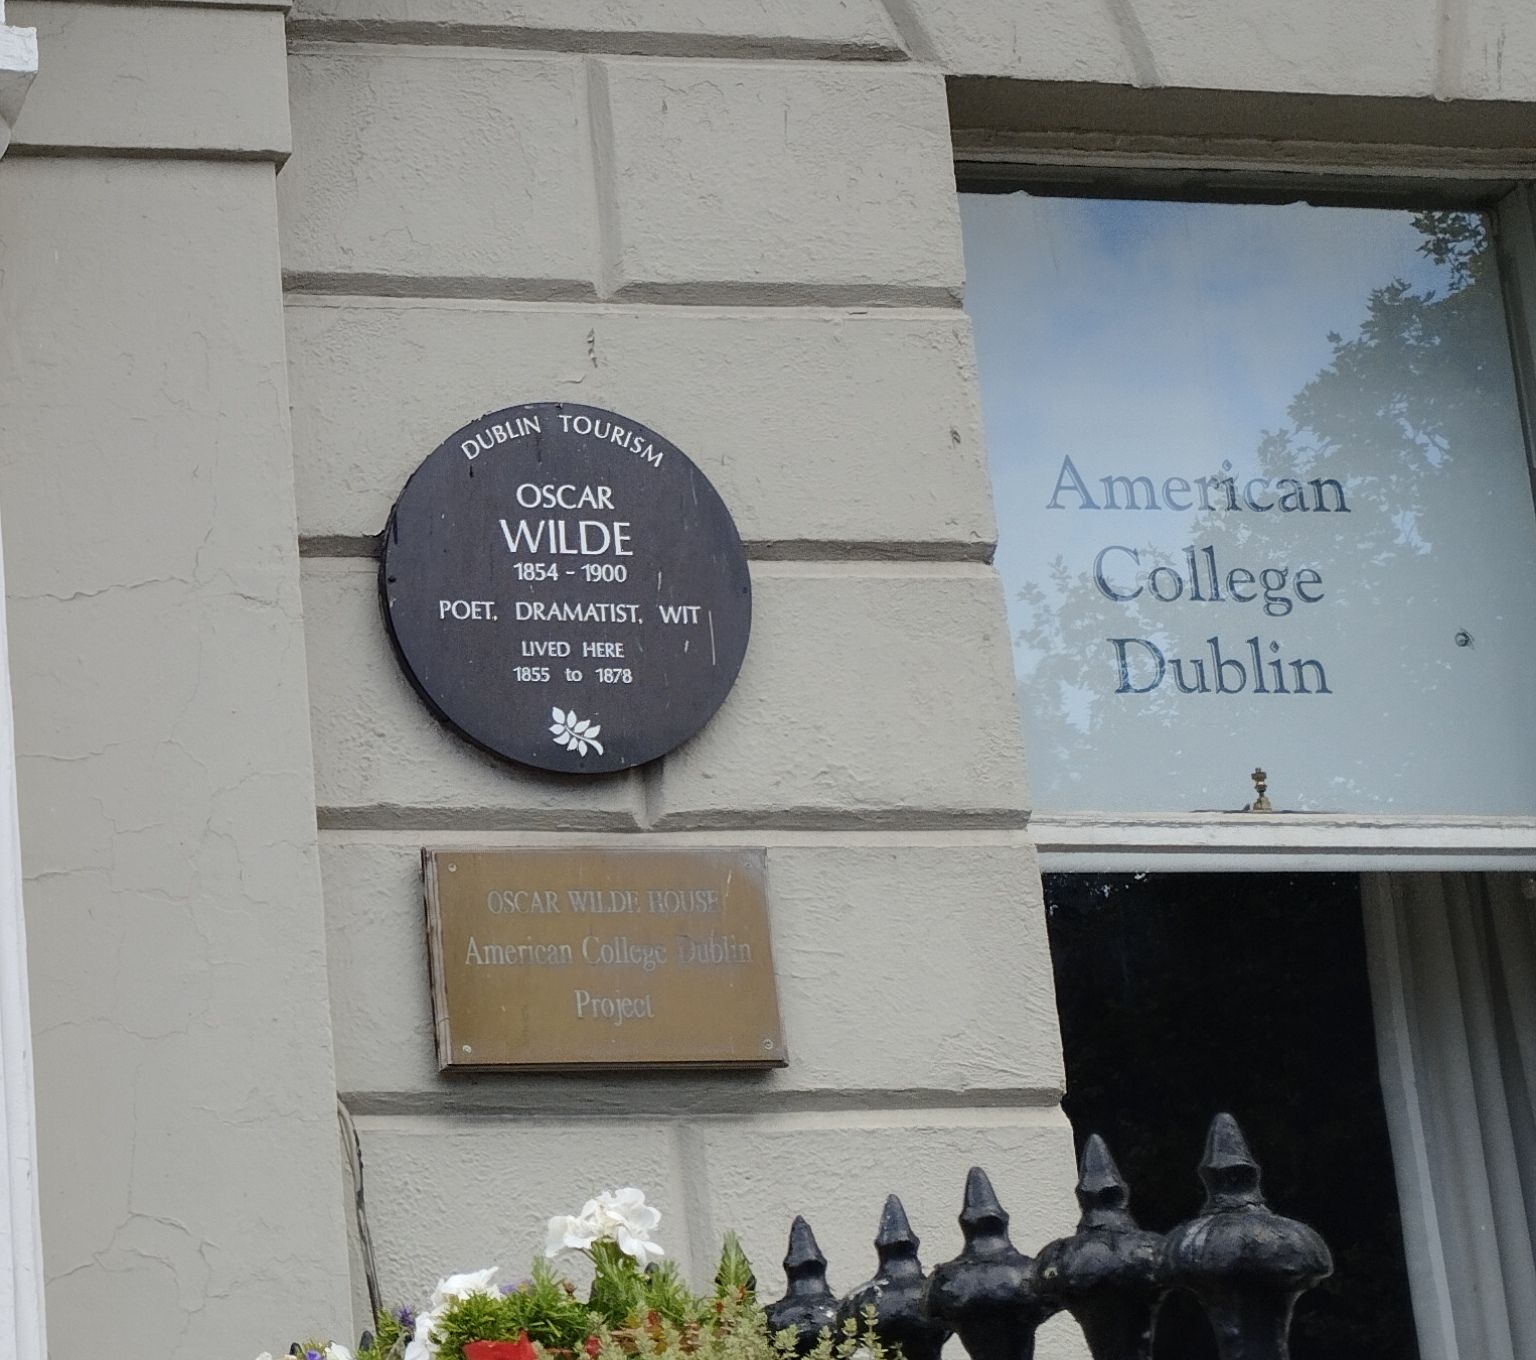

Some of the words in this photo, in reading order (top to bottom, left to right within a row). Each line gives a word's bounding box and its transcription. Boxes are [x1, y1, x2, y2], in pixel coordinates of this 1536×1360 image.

[461, 415, 542, 461] DUBLIN
[558, 414, 665, 469] TOURISM
[515, 483, 615, 510] OSCAR
[1045, 453, 1352, 514] American
[498, 519, 634, 556] WILDE
[513, 562, 559, 582] 1854
[580, 563, 628, 583] 1900
[1092, 544, 1326, 618] College
[658, 605, 702, 625] WIT
[521, 641, 571, 658] LIVED
[581, 642, 625, 658] HERE
[1105, 635, 1333, 695] Dublin
[512, 666, 550, 683] 1855
[565, 667, 583, 683] to
[595, 667, 633, 685] 1878
[487, 890, 560, 914] OSCAR
[568, 890, 640, 914] WILDE
[648, 890, 719, 914] HOUSE
[465, 936, 573, 966] American
[582, 936, 666, 970] College
[678, 935, 752, 964] Dublin
[575, 990, 655, 1025] Project
